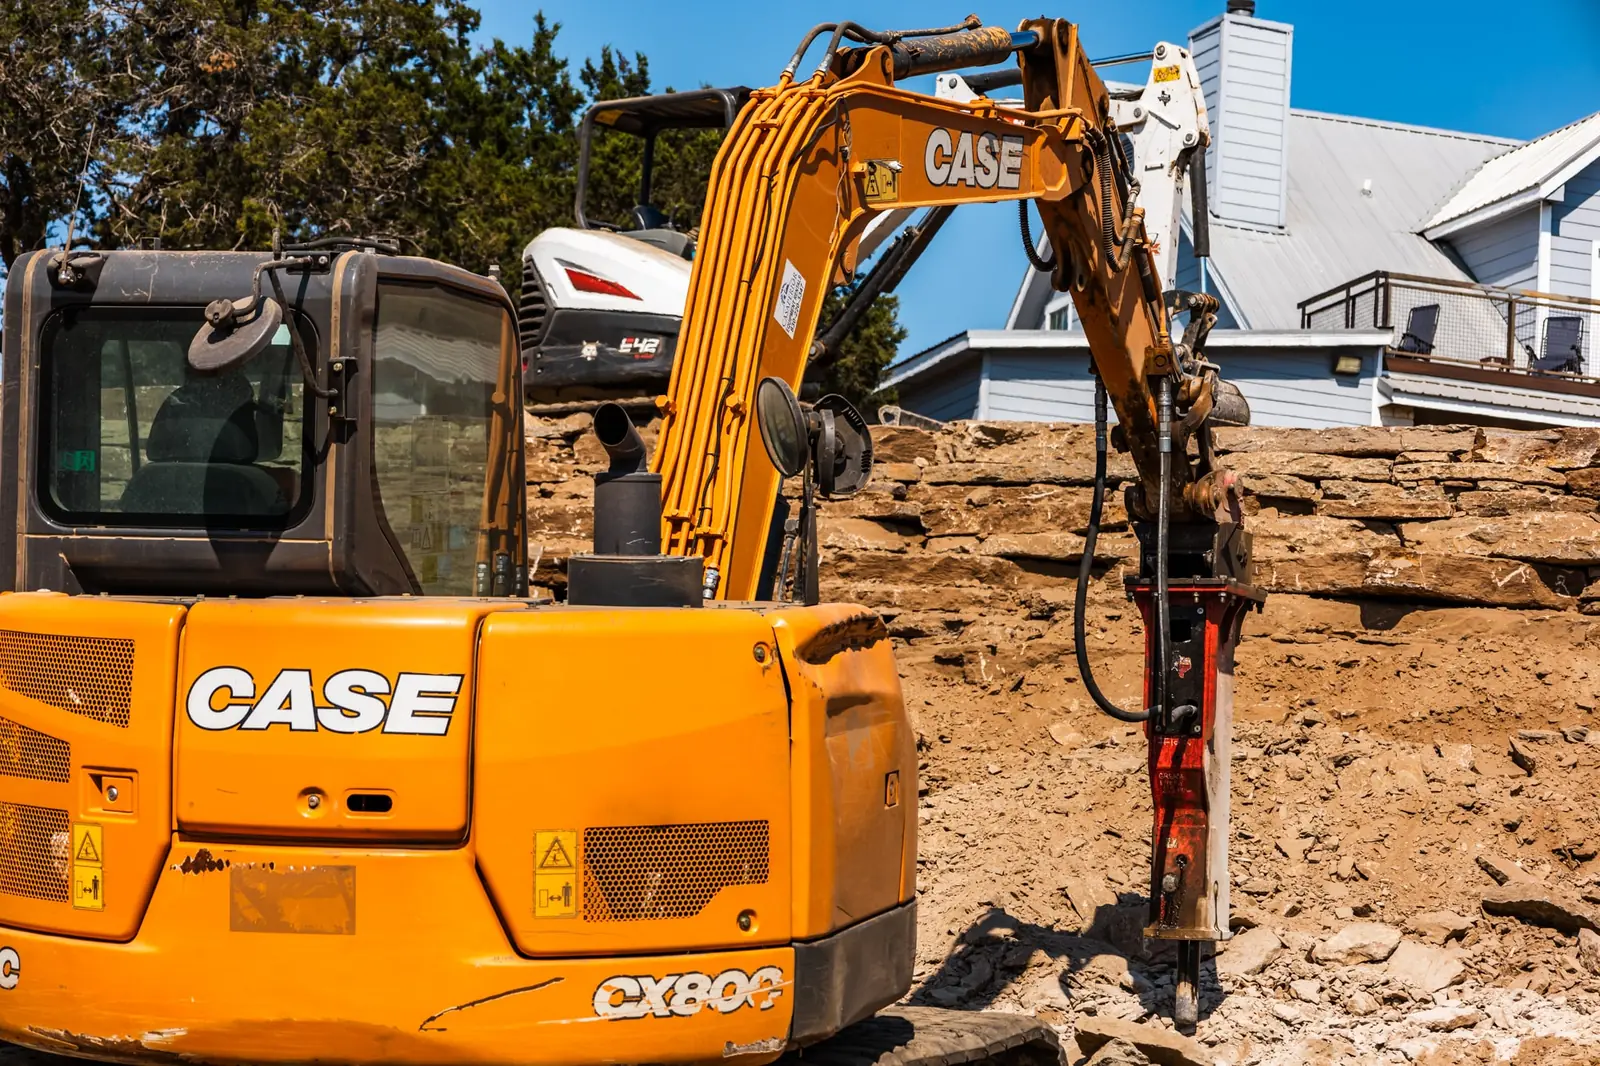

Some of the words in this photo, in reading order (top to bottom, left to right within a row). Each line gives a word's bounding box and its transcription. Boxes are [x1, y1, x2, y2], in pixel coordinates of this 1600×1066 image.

[924, 127, 1024, 190] CASE
[785, 299, 796, 333] EQUIPMENT
[793, 273, 802, 301] RENTALS
[617, 336, 660, 353] E42
[186, 665, 465, 736] CASE
